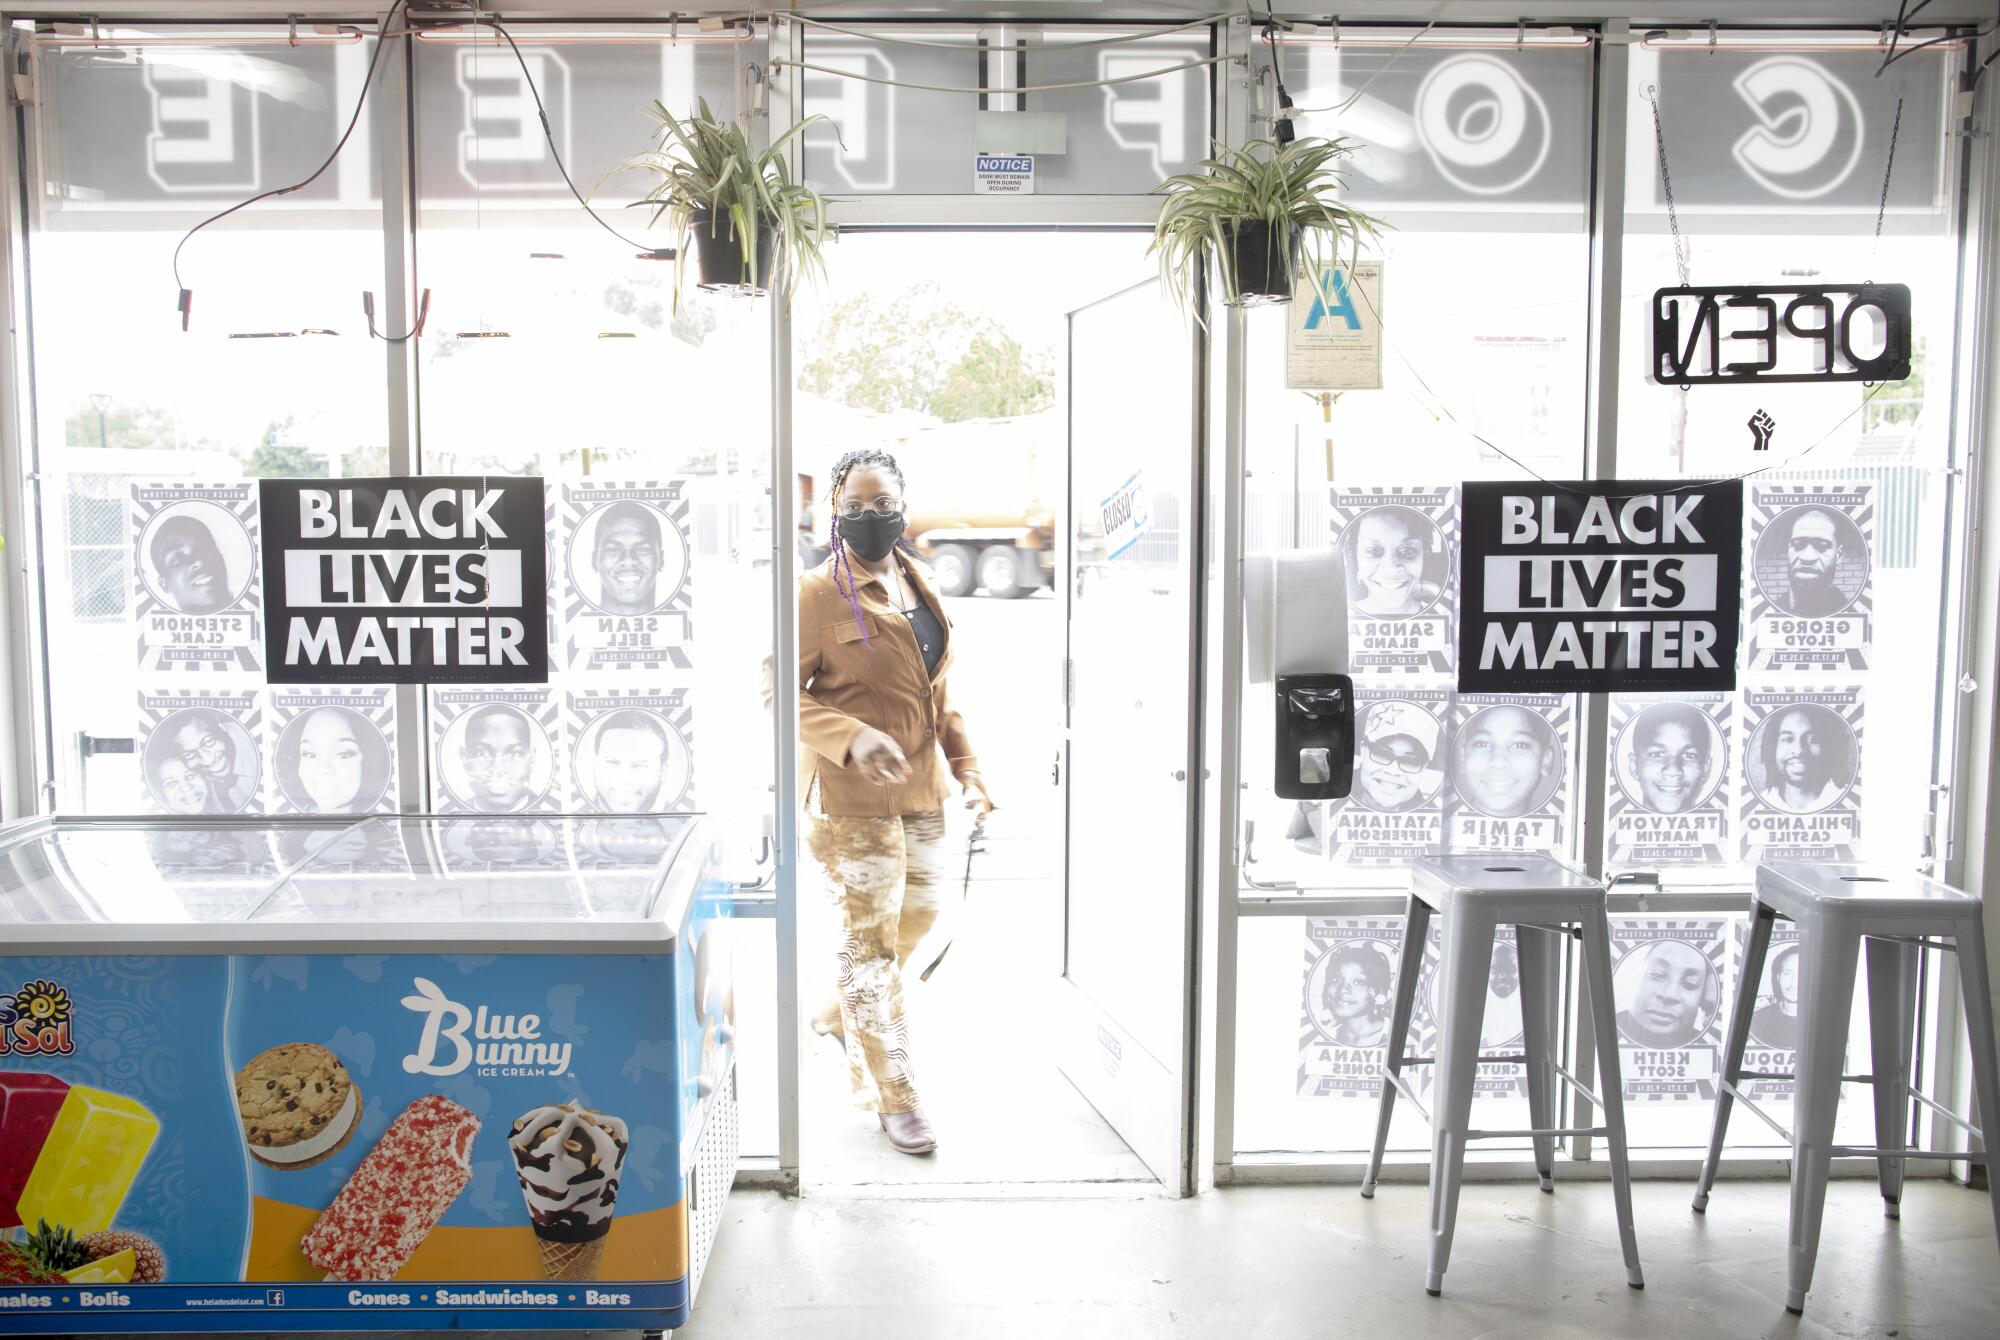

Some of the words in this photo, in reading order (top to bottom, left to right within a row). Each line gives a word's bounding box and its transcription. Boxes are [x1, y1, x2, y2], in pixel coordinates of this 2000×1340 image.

[979, 159, 1031, 170] NOTICE
[1303, 269, 1362, 330] A
[299, 488, 508, 539] BLACK
[1103, 491, 1131, 536] CLOSED
[1502, 495, 1706, 545] BLACK
[319, 553, 488, 605] LIVES
[1518, 558, 1685, 608] LIVES
[285, 617, 529, 666] MATTER
[1479, 621, 1720, 670] MATTER
[14, 1018, 72, 1052] Sol
[478, 1068, 497, 1076] ICE
[502, 1068, 544, 1077] CREAM
[80, 1290, 130, 1306] Bolis
[348, 1290, 411, 1305] Cones
[435, 1288, 558, 1305] Sandwiches
[585, 1290, 631, 1305] Bars
